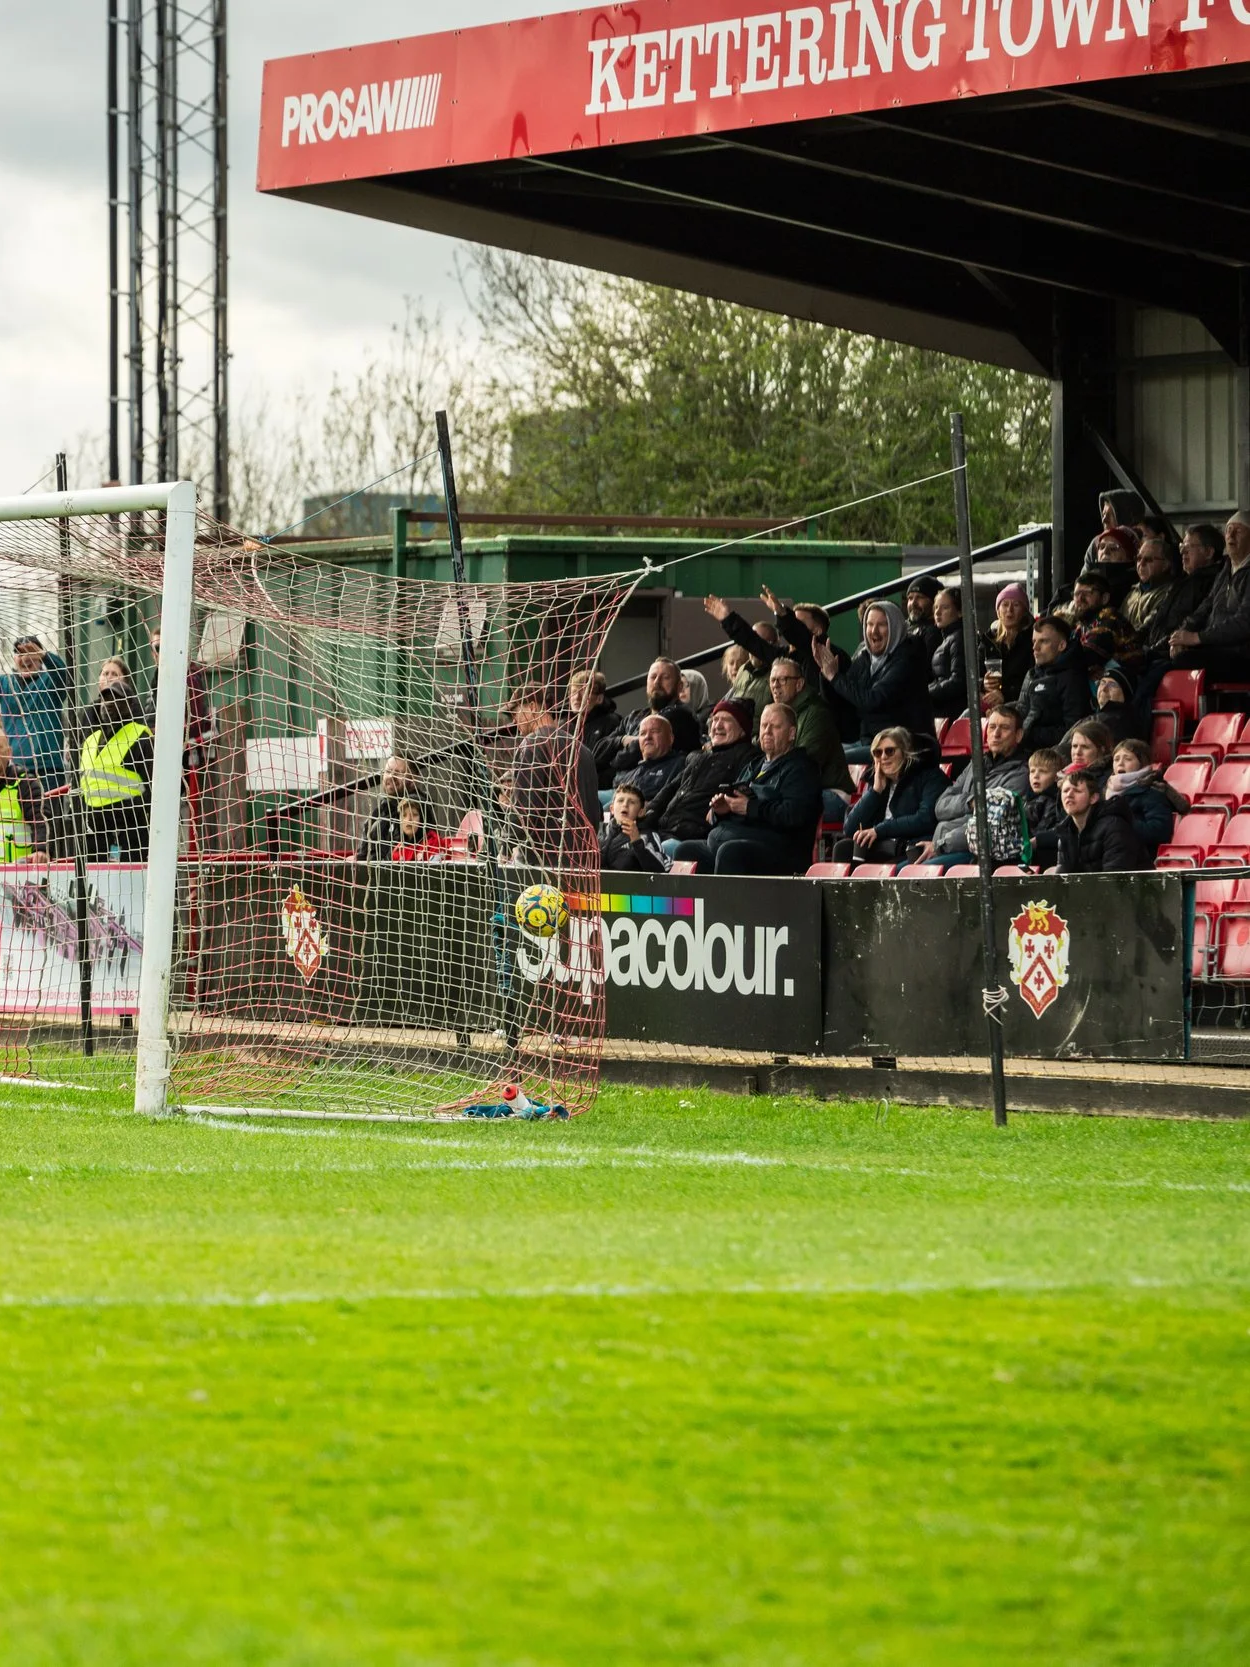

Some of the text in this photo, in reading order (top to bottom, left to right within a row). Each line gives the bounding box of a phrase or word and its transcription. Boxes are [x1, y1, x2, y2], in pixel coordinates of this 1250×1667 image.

[585, 0, 1151, 116] KETTERING TOWN
[281, 79, 403, 148] PROSAW
[346, 729, 390, 750] TOILETS
